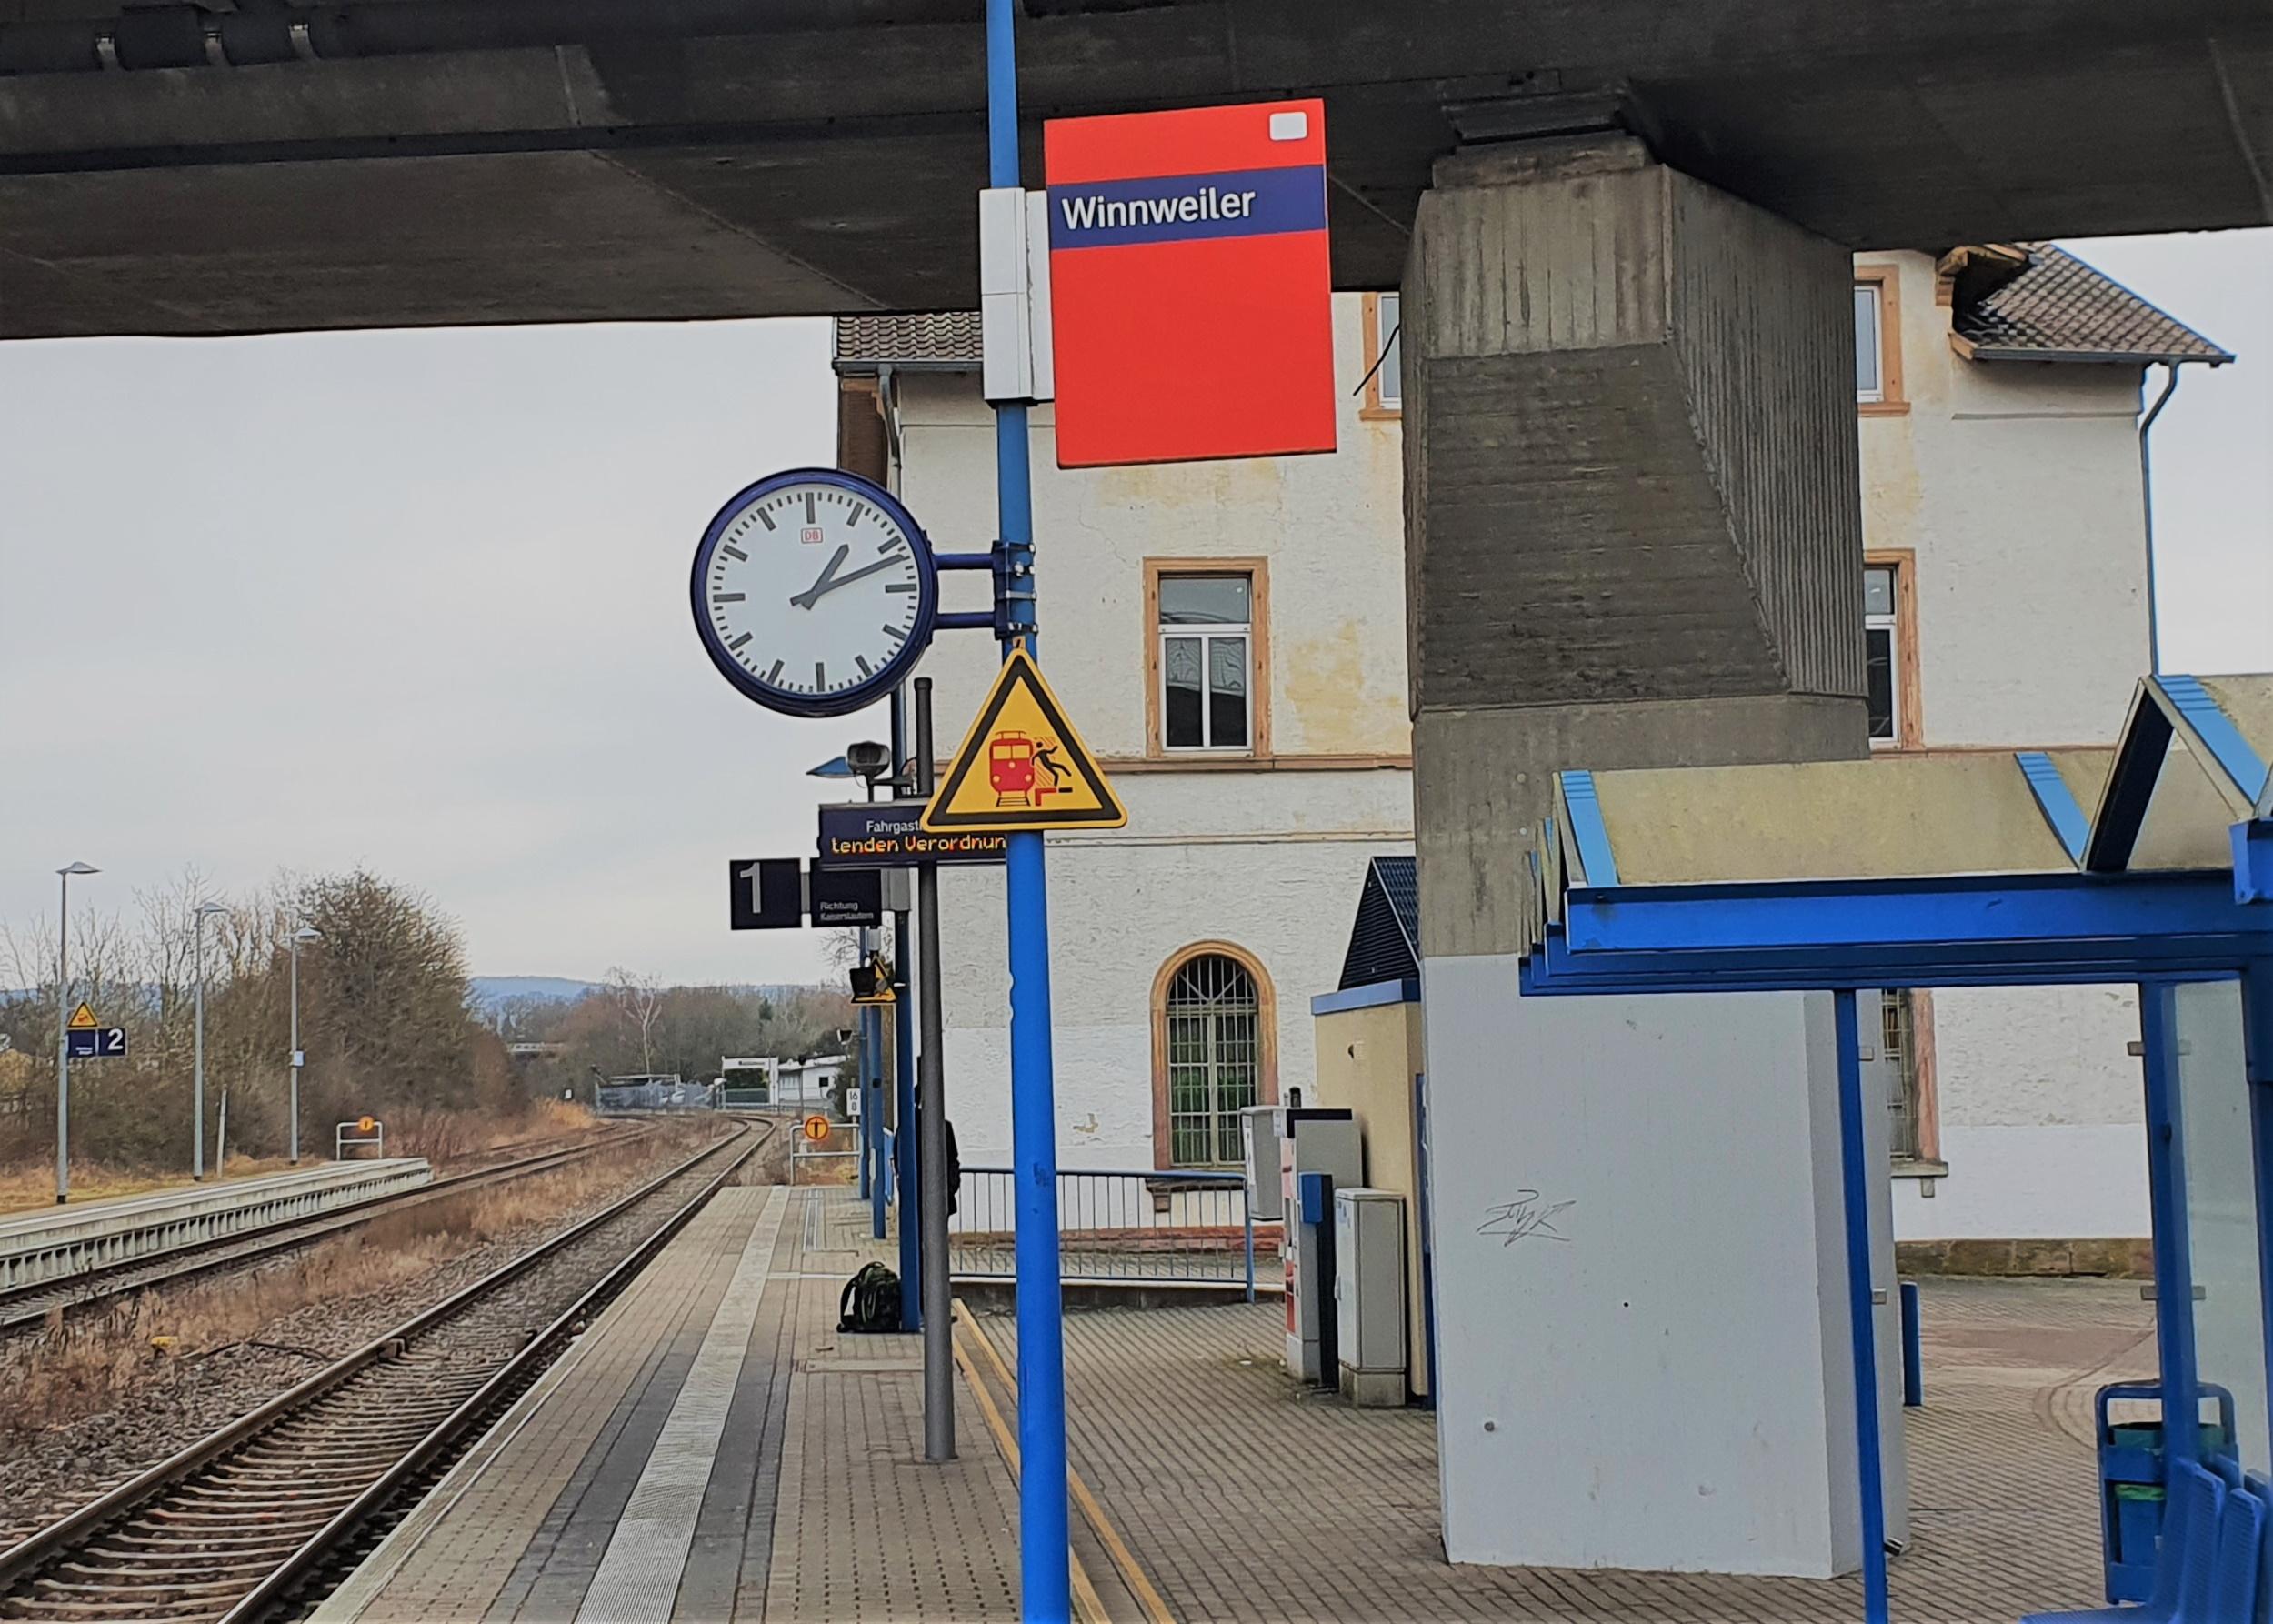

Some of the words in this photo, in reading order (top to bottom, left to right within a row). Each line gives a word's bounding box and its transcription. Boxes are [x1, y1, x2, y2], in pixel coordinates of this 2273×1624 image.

[1061, 186, 1257, 230] Winnweiler
[803, 529, 820, 542] DB
[831, 837, 899, 854] tenden
[739, 861, 762, 914] 1
[107, 1028, 124, 1050] 2
[849, 1090, 858, 1100] 16
